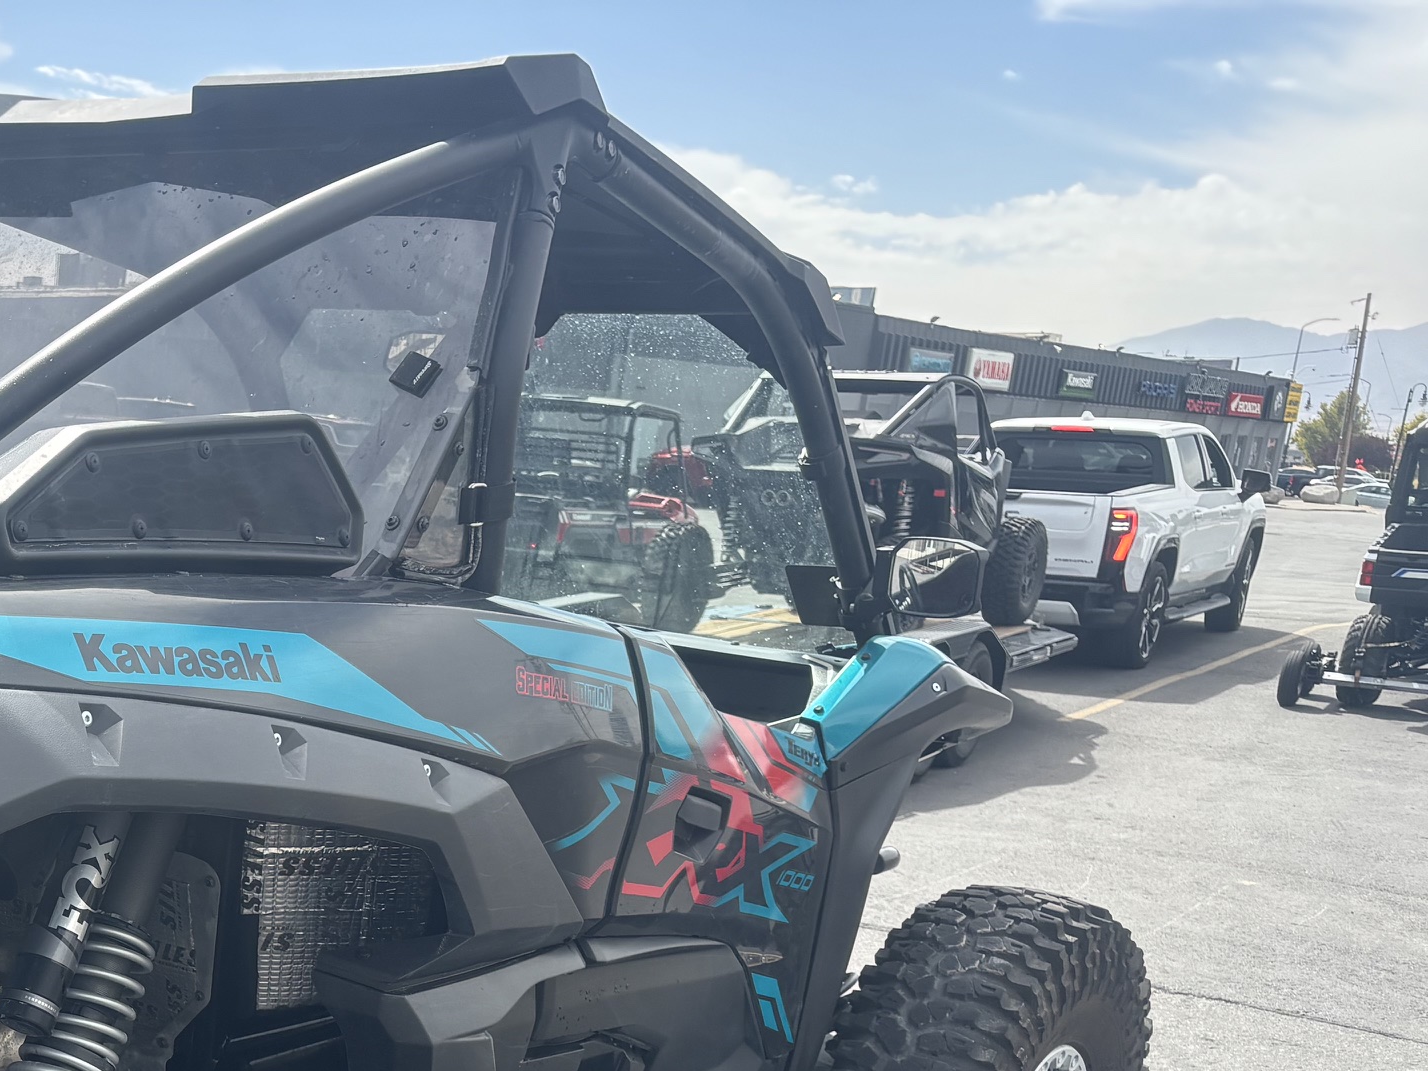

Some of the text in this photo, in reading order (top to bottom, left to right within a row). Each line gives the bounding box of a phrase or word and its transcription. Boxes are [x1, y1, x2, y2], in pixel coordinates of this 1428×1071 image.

[982, 359, 1010, 381] YAMAHA
[1237, 401, 1261, 415] HONDA
[73, 632, 282, 683] Kawasaki
[515, 665, 613, 712] SPECIAL EDITION
[48, 824, 121, 943] FOX
[776, 870, 814, 891] 1000
